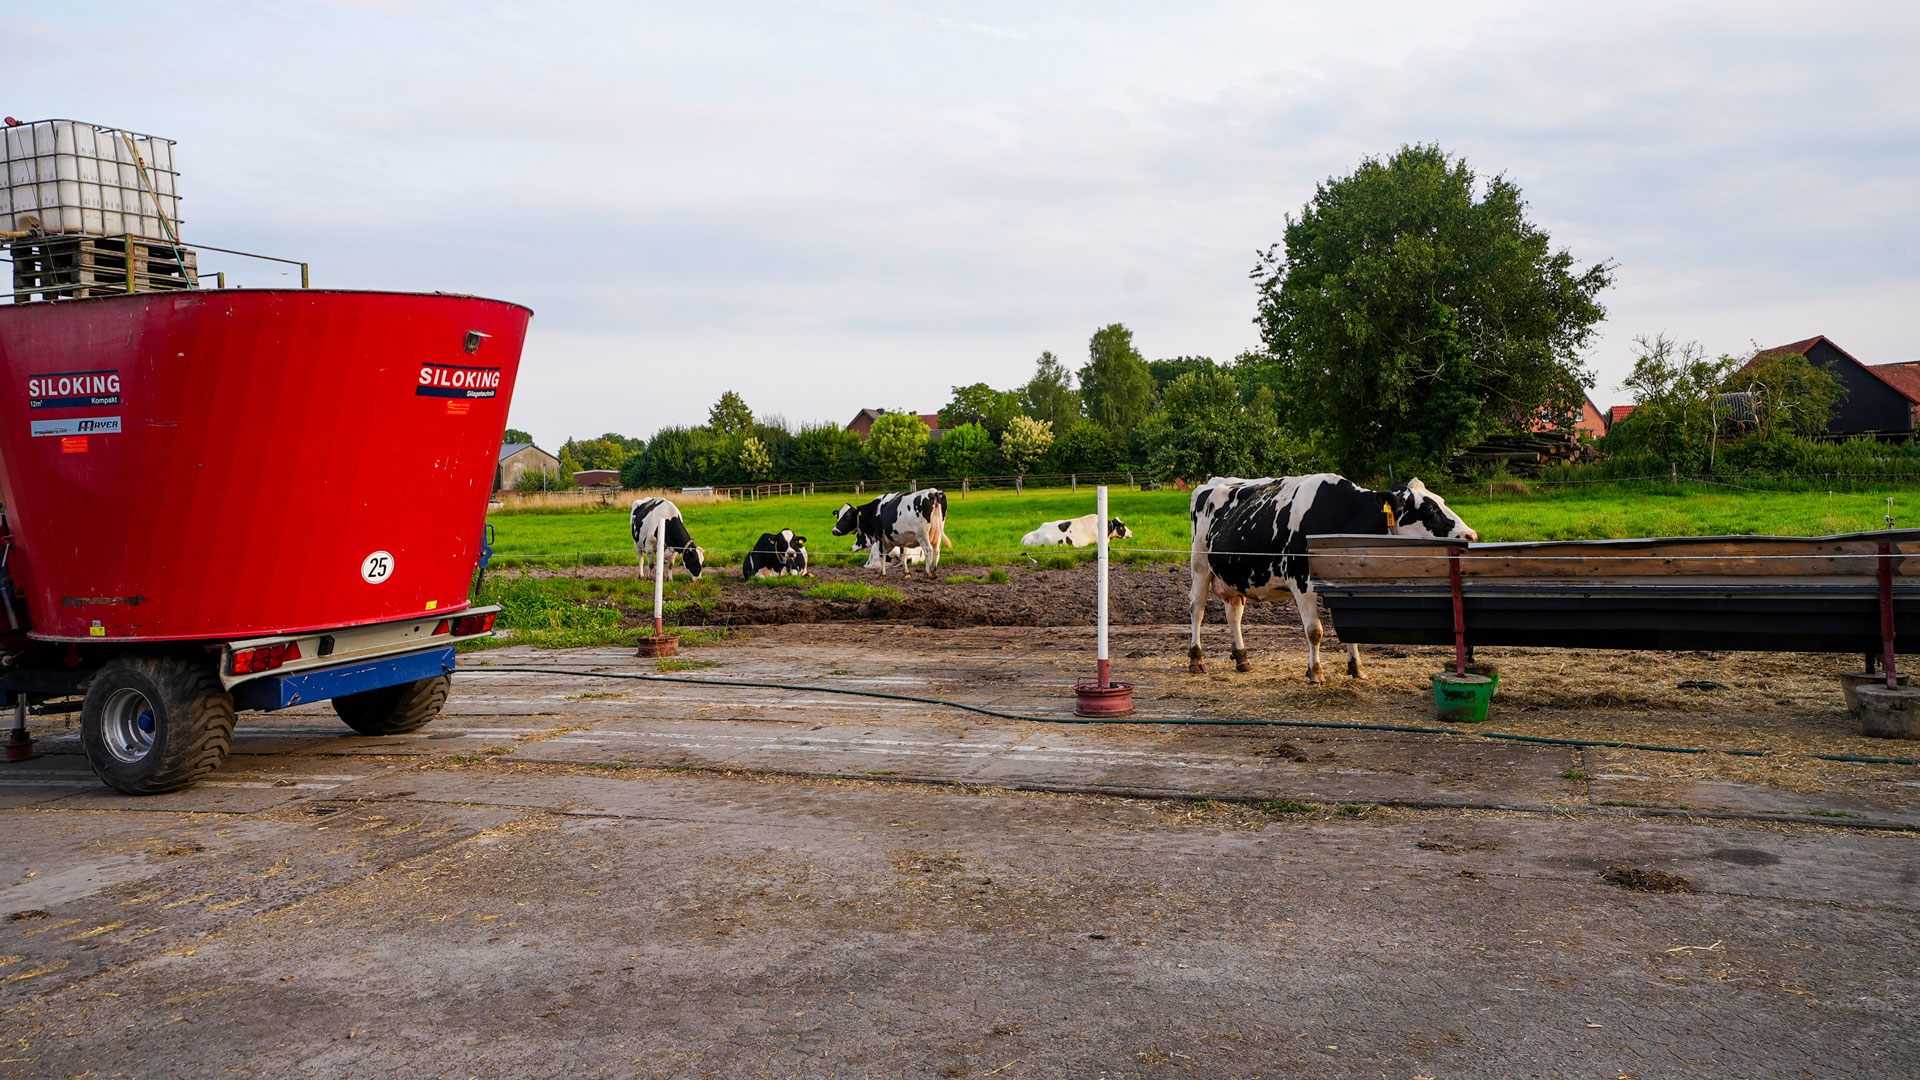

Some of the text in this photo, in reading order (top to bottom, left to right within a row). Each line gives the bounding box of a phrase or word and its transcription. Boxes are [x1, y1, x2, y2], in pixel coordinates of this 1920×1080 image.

[28, 375, 120, 397] SILOKING
[418, 367, 500, 388] SILOKING
[91, 396, 118, 405] Kompakt
[368, 557, 389, 578] 25
